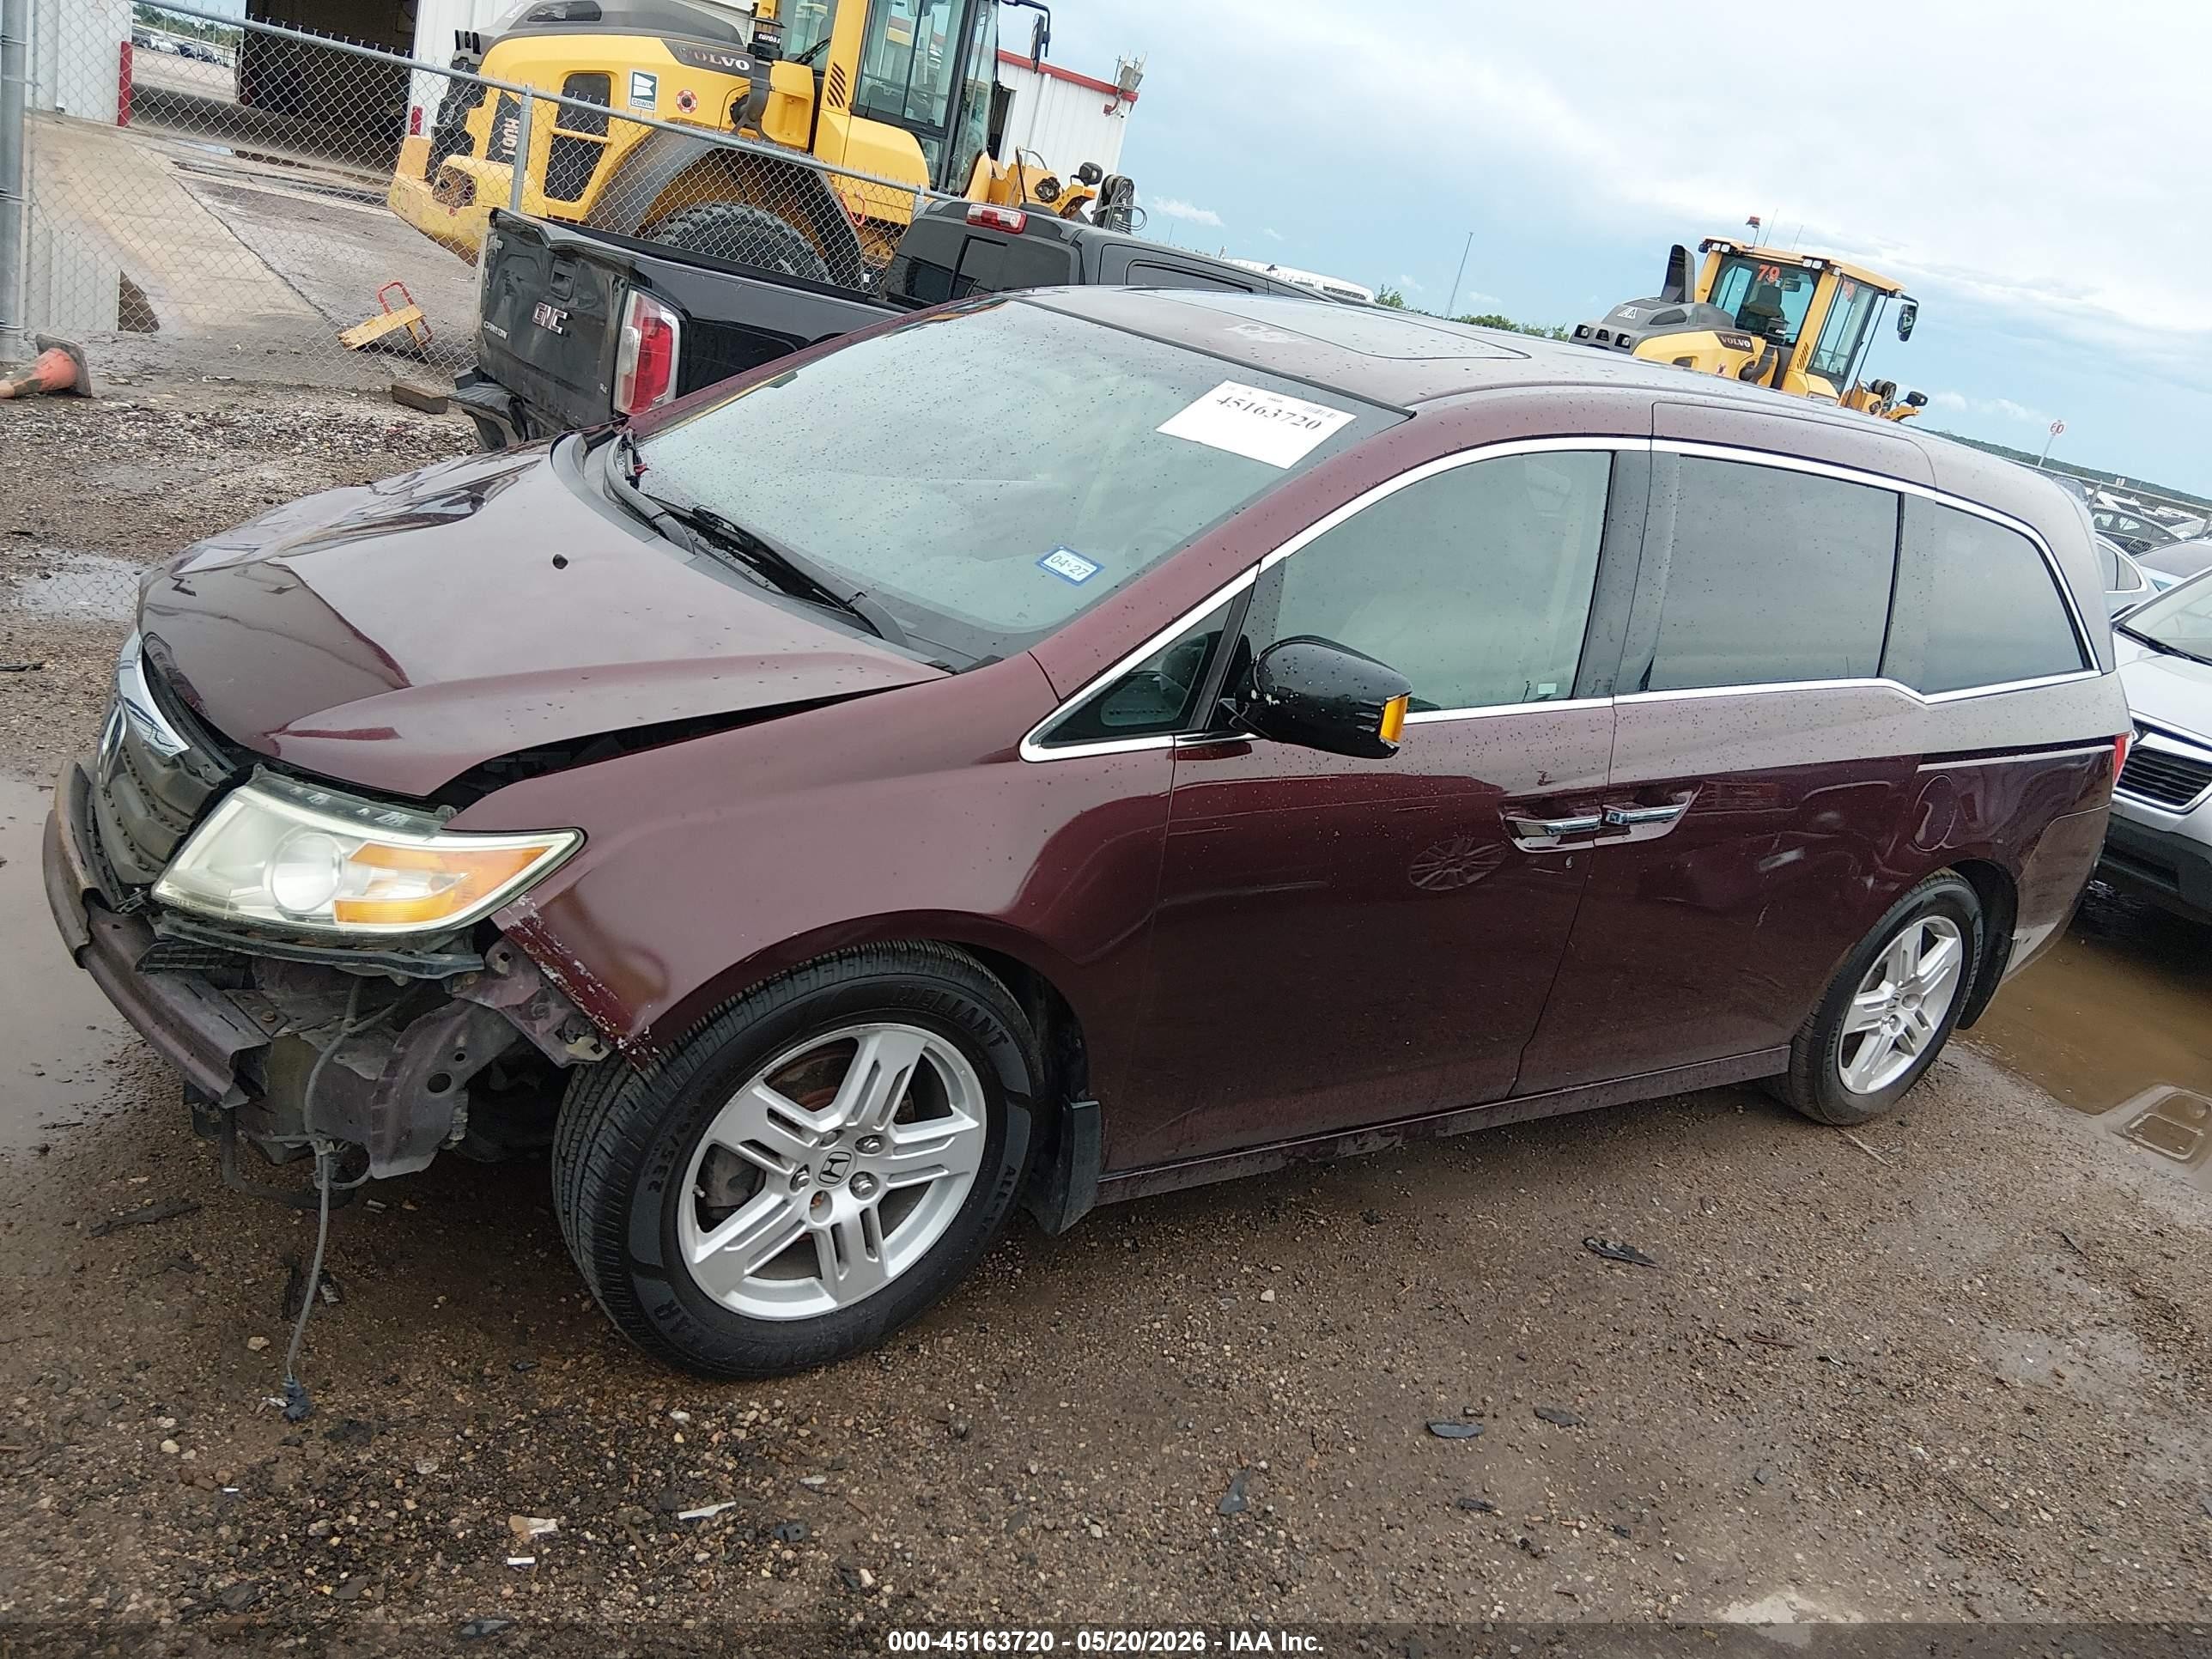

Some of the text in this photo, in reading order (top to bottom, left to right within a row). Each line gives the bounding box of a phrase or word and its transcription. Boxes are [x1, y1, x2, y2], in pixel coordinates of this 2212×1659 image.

[632, 98, 653, 107] COWIN
[1758, 264, 1780, 283] 79
[532, 301, 568, 334] GMC
[1720, 336, 1751, 348] VOLVO
[1216, 396, 1322, 430] 45163720
